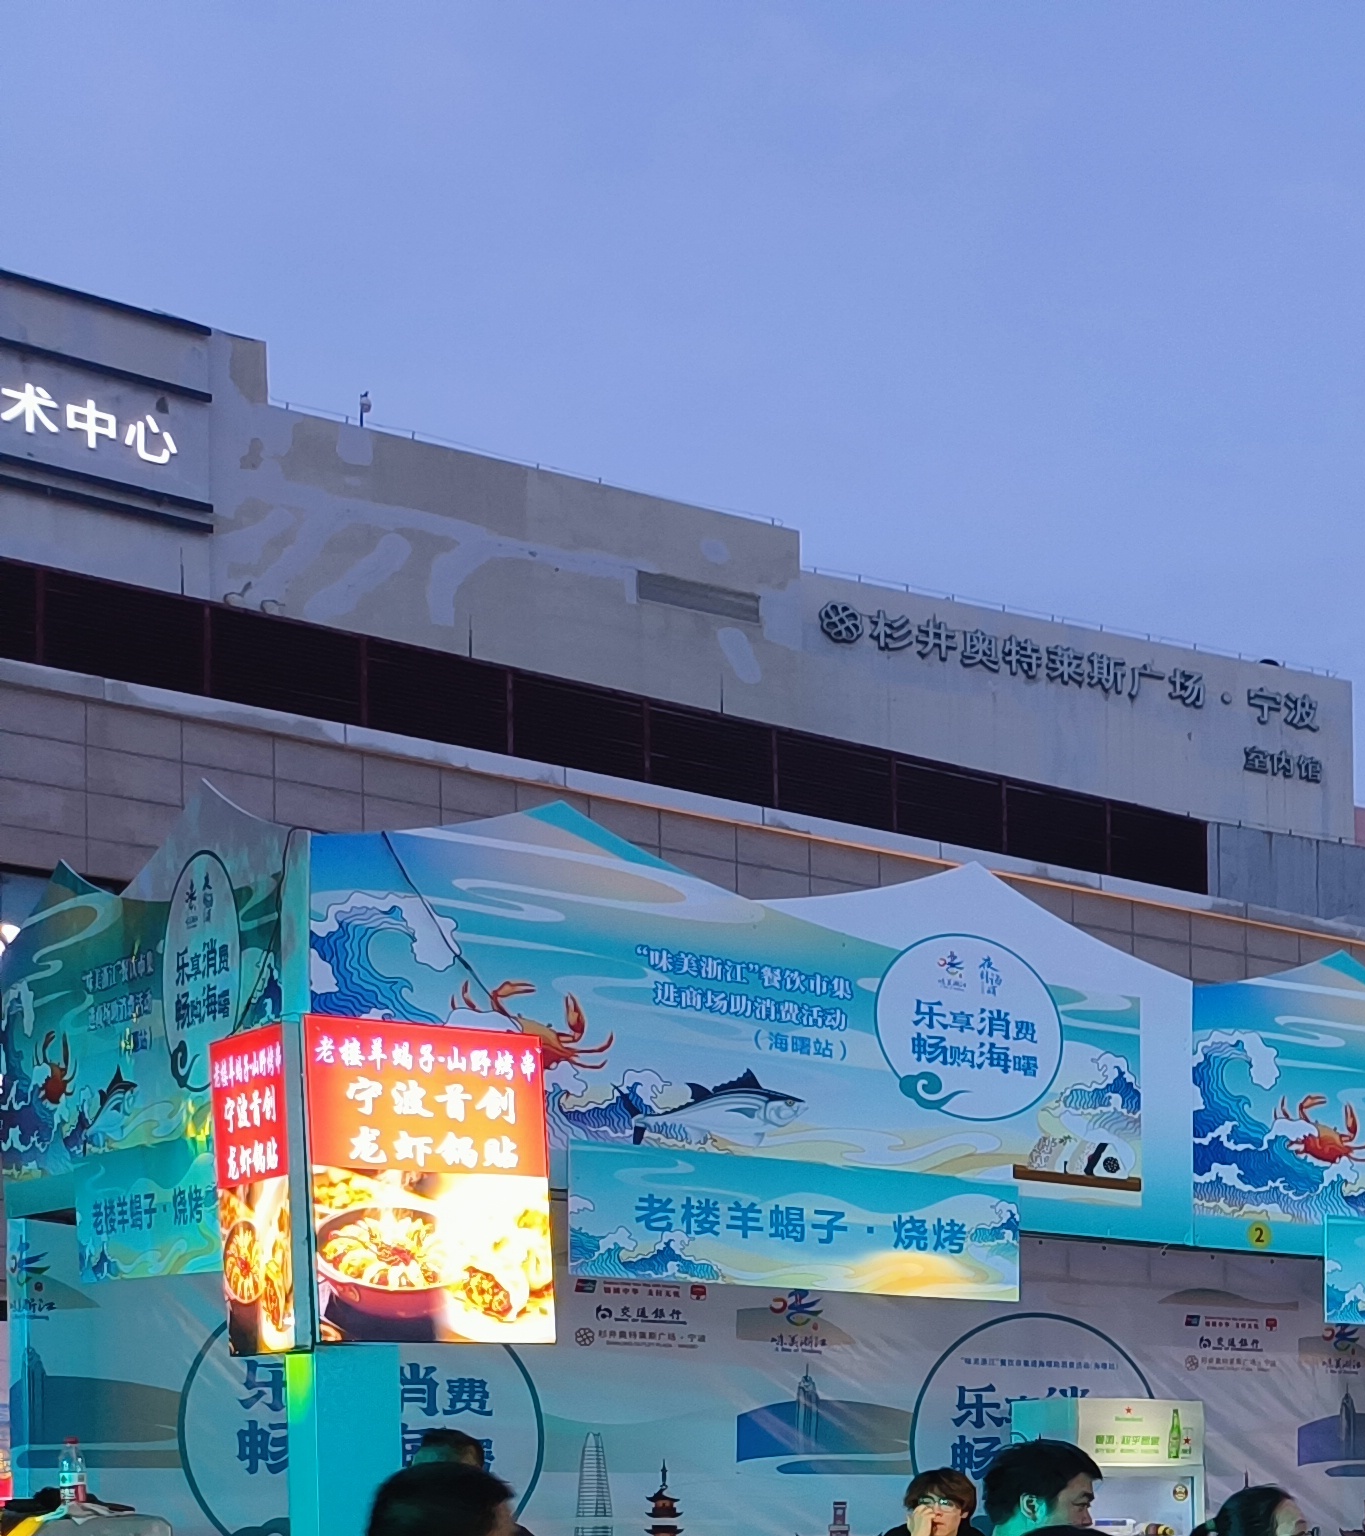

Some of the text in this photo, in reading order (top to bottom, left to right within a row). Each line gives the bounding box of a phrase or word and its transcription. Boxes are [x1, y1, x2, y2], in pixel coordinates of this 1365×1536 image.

[0, 383, 178, 465] 术中心
[1244, 745, 1323, 784] 室内馆
[653, 981, 848, 1031] 进商场助消费活动
[912, 998, 1038, 1044] 乐享消费
[911, 1032, 1038, 1078] 畅购海曙
[346, 1076, 516, 1124] 宁波首创
[350, 1126, 518, 1168] 龙虾锅贴
[634, 1193, 966, 1256] 老楼羊蝎子·烧烤
[1254, 1227, 1265, 1243] 2
[621, 1305, 682, 1320] 交通银行
[238, 1359, 493, 1417] 乐消费
